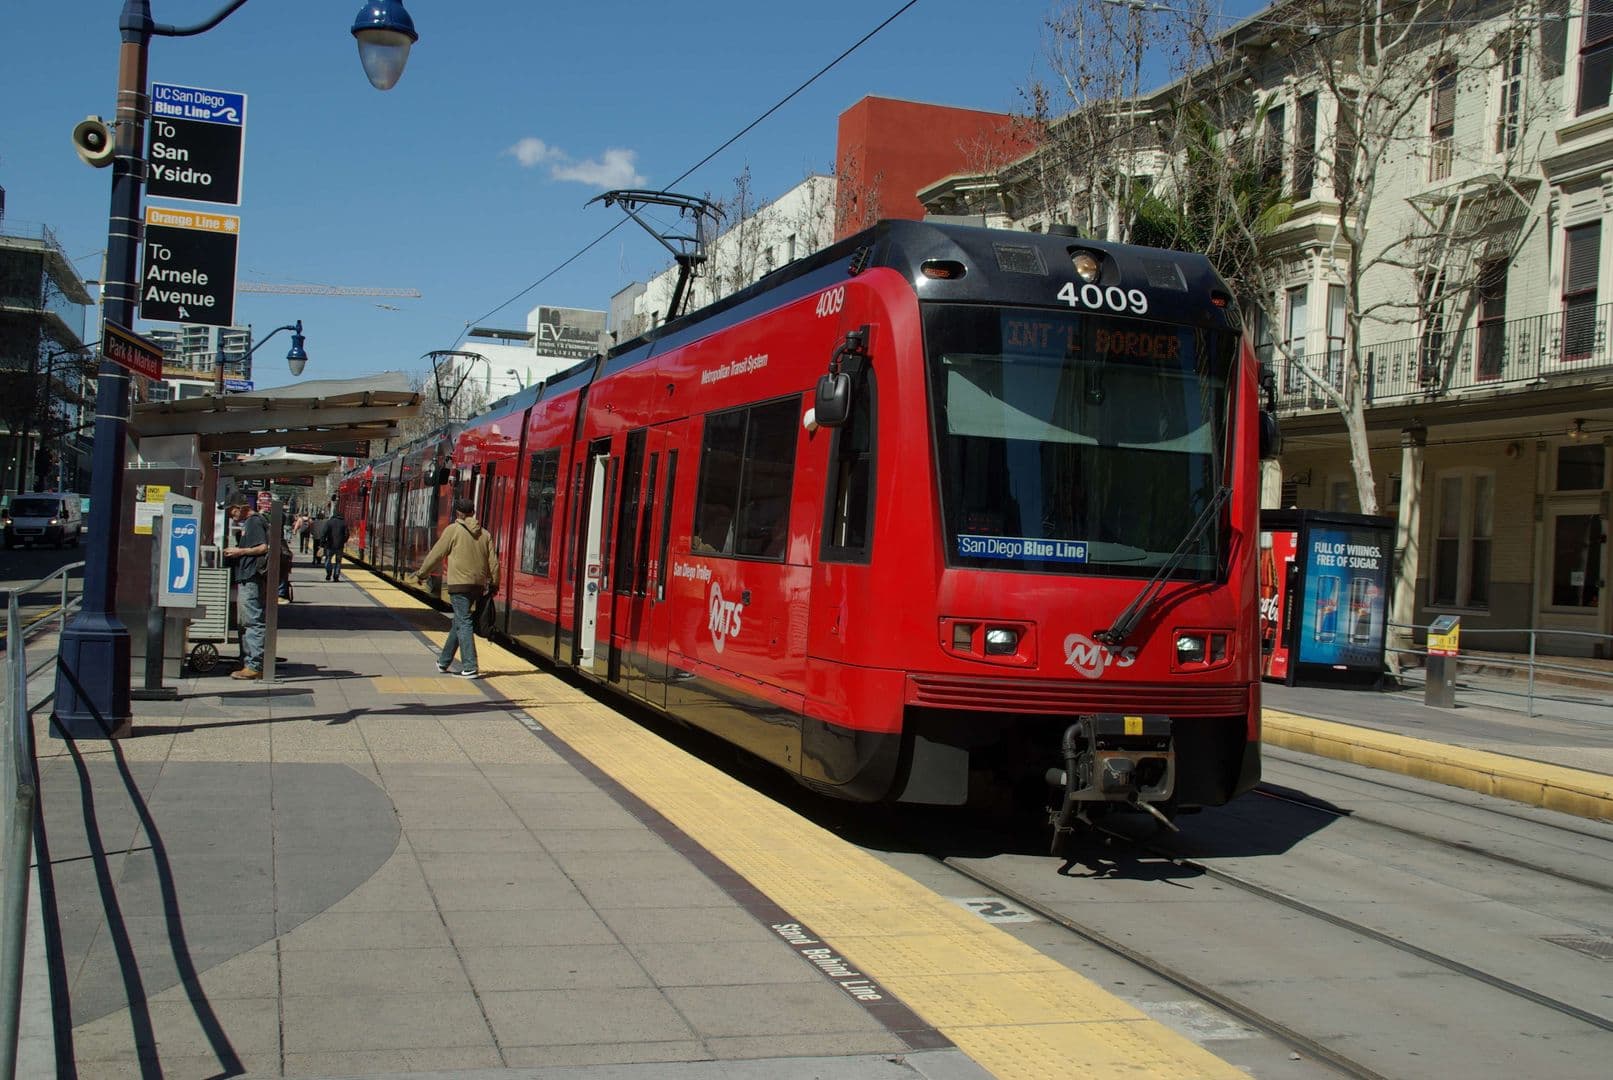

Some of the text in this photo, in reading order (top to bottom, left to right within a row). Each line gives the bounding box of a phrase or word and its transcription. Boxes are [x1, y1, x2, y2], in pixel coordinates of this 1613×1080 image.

[155, 87, 225, 108] UC San Diego
[154, 101, 211, 119] Blue Line
[154, 120, 176, 138] To
[152, 142, 189, 161] San
[151, 163, 212, 185] Ysidro
[151, 211, 220, 229] Orange Line
[149, 243, 171, 260] To
[147, 264, 208, 285] Arnele
[145, 285, 215, 307] Avenue
[816, 286, 845, 318] 4009
[1056, 282, 1149, 315] 4009
[1007, 320, 1181, 360] INT'L BORDER
[109, 337, 158, 374] Park & Market
[701, 354, 768, 384] Metropolitan Transit System
[962, 538, 986, 553] San
[987, 539, 1022, 558] Diego
[1023, 541, 1054, 557] Blue
[1055, 543, 1085, 558] Line
[1314, 541, 1333, 554] FULL
[1334, 543, 1346, 555] OF
[673, 562, 682, 577] San
[682, 563, 696, 581] Diego
[696, 564, 712, 584] Trolley
[1316, 554, 1379, 570] FREE OF SUGAR.
[708, 599, 743, 637] MTS
[1064, 644, 1138, 668] MTS
[772, 923, 882, 1000] Stand Behind Line
